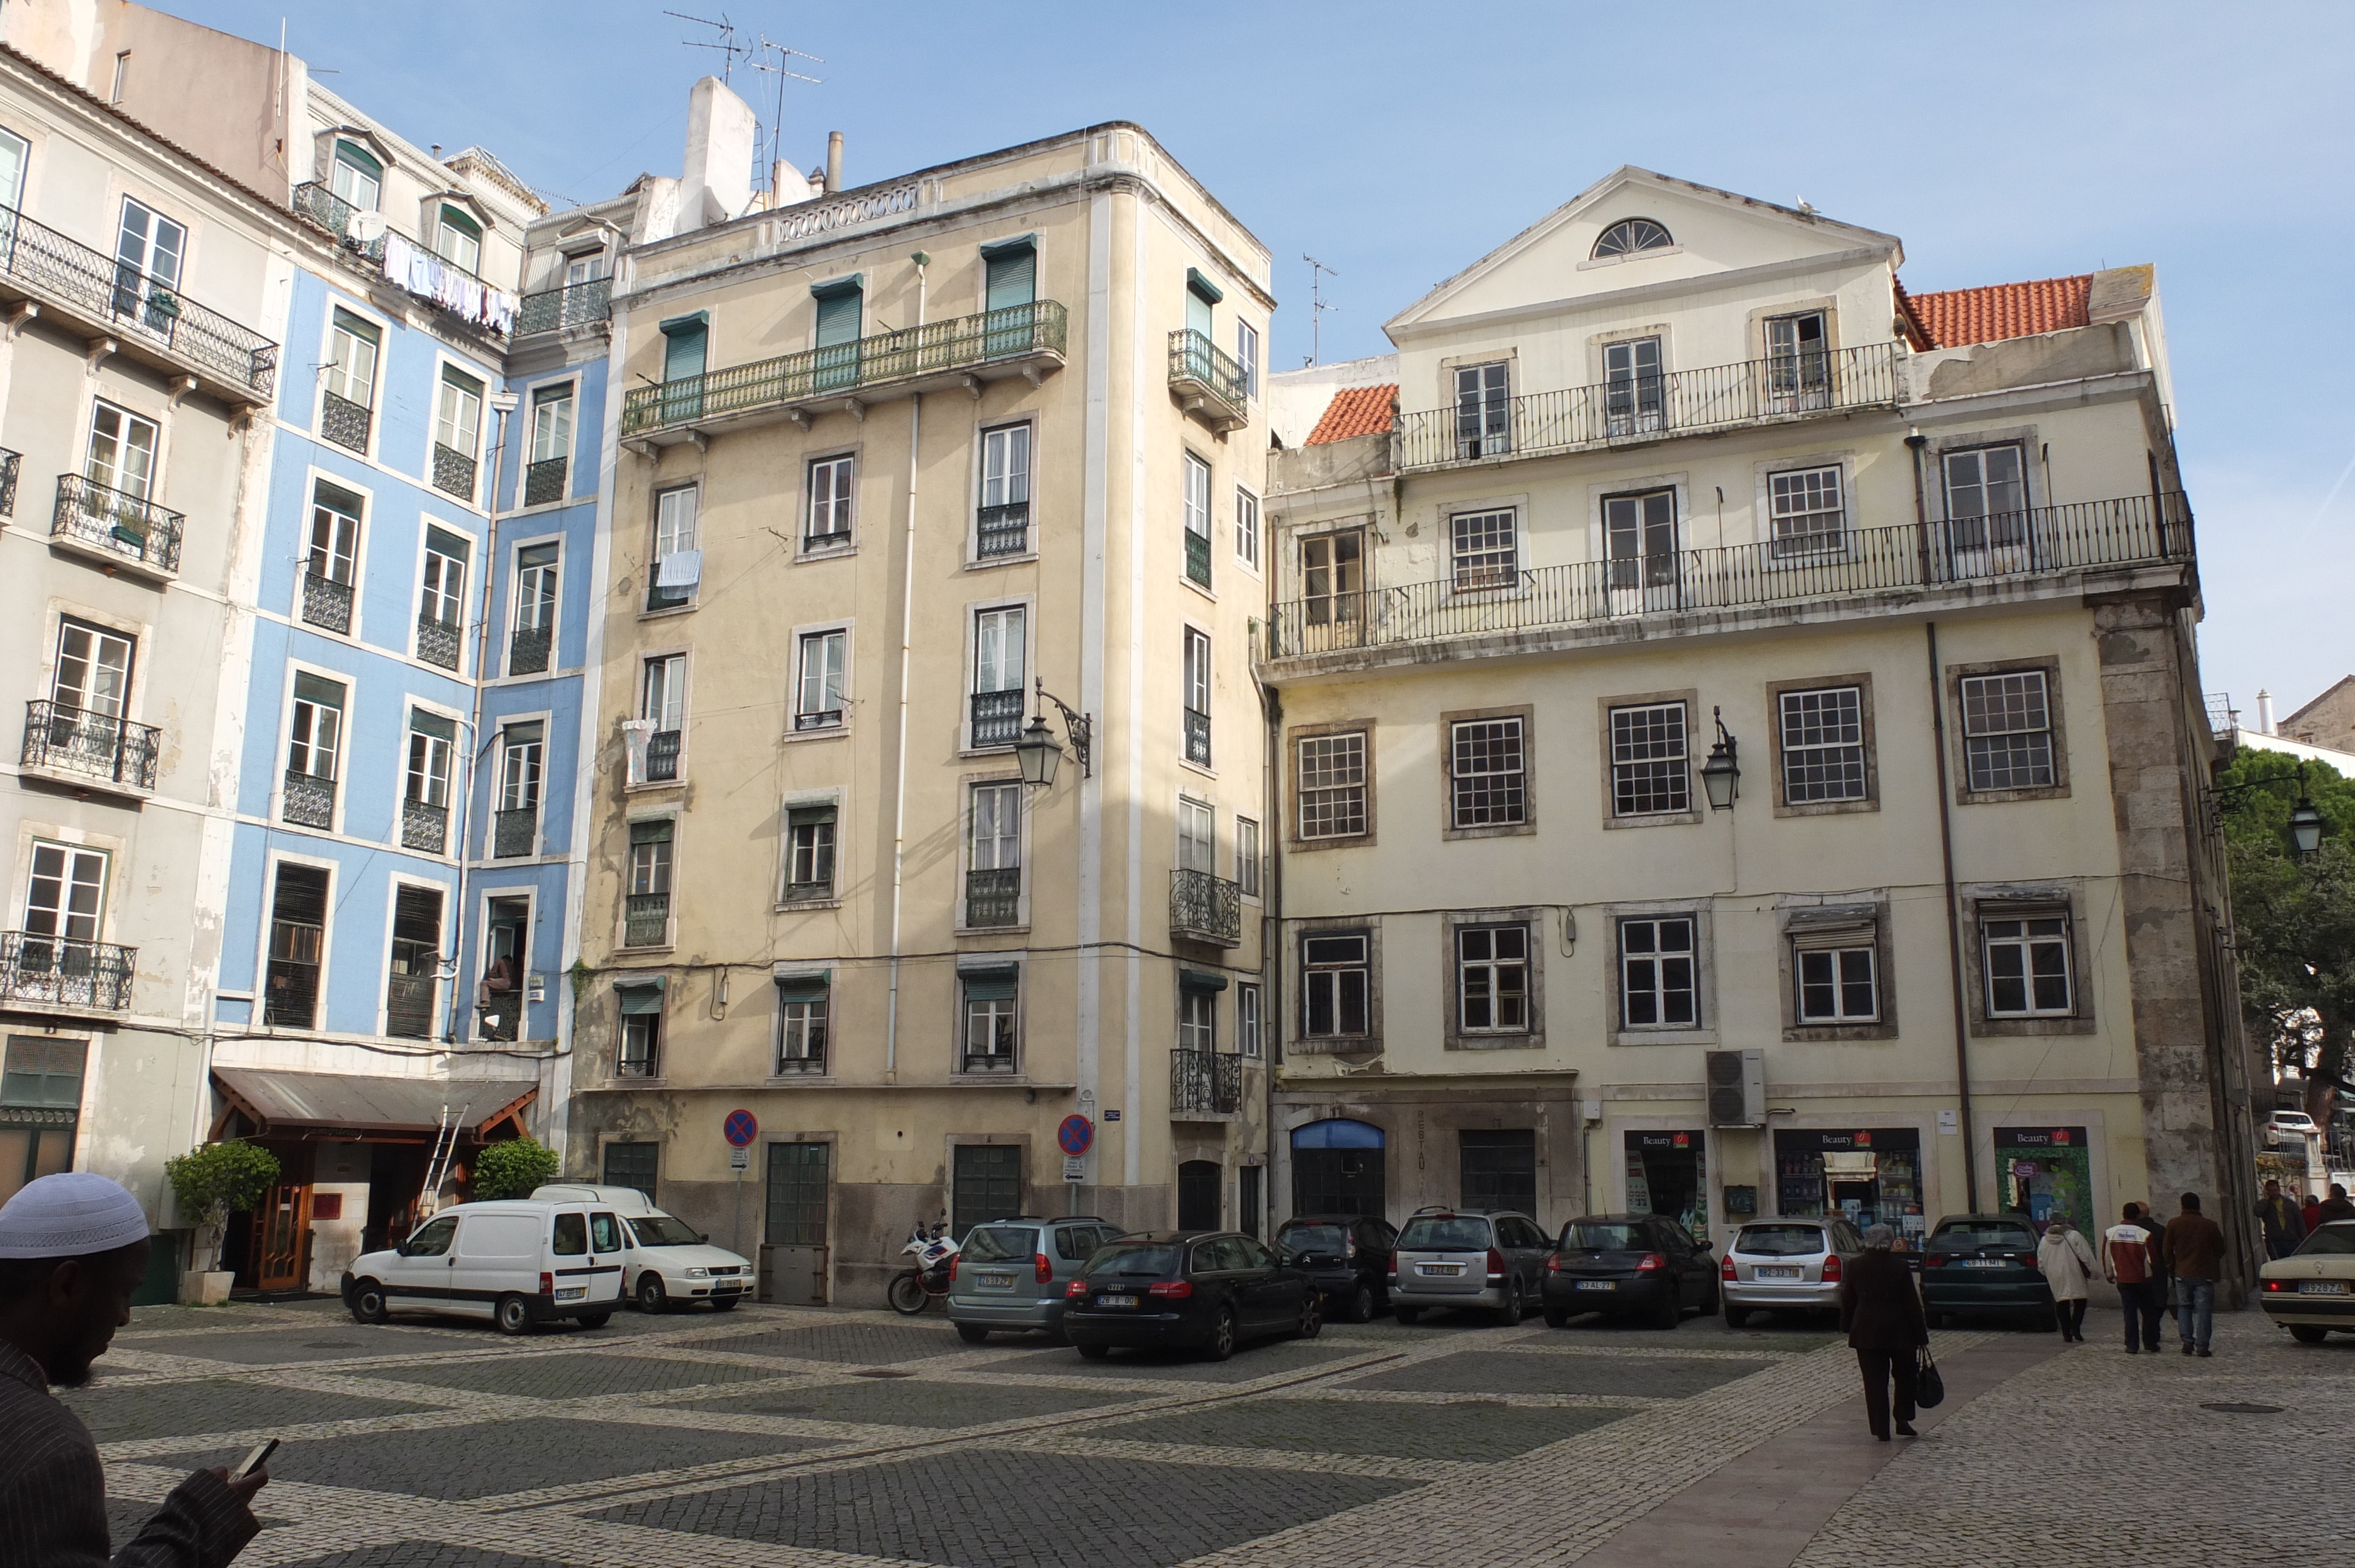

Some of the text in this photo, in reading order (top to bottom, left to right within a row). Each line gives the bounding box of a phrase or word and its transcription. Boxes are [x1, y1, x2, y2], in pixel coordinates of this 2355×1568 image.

[1643, 1137, 1671, 1147] Beauty
[1822, 1135, 1852, 1145] Beauty
[2017, 1134, 2049, 1144] Beauty
